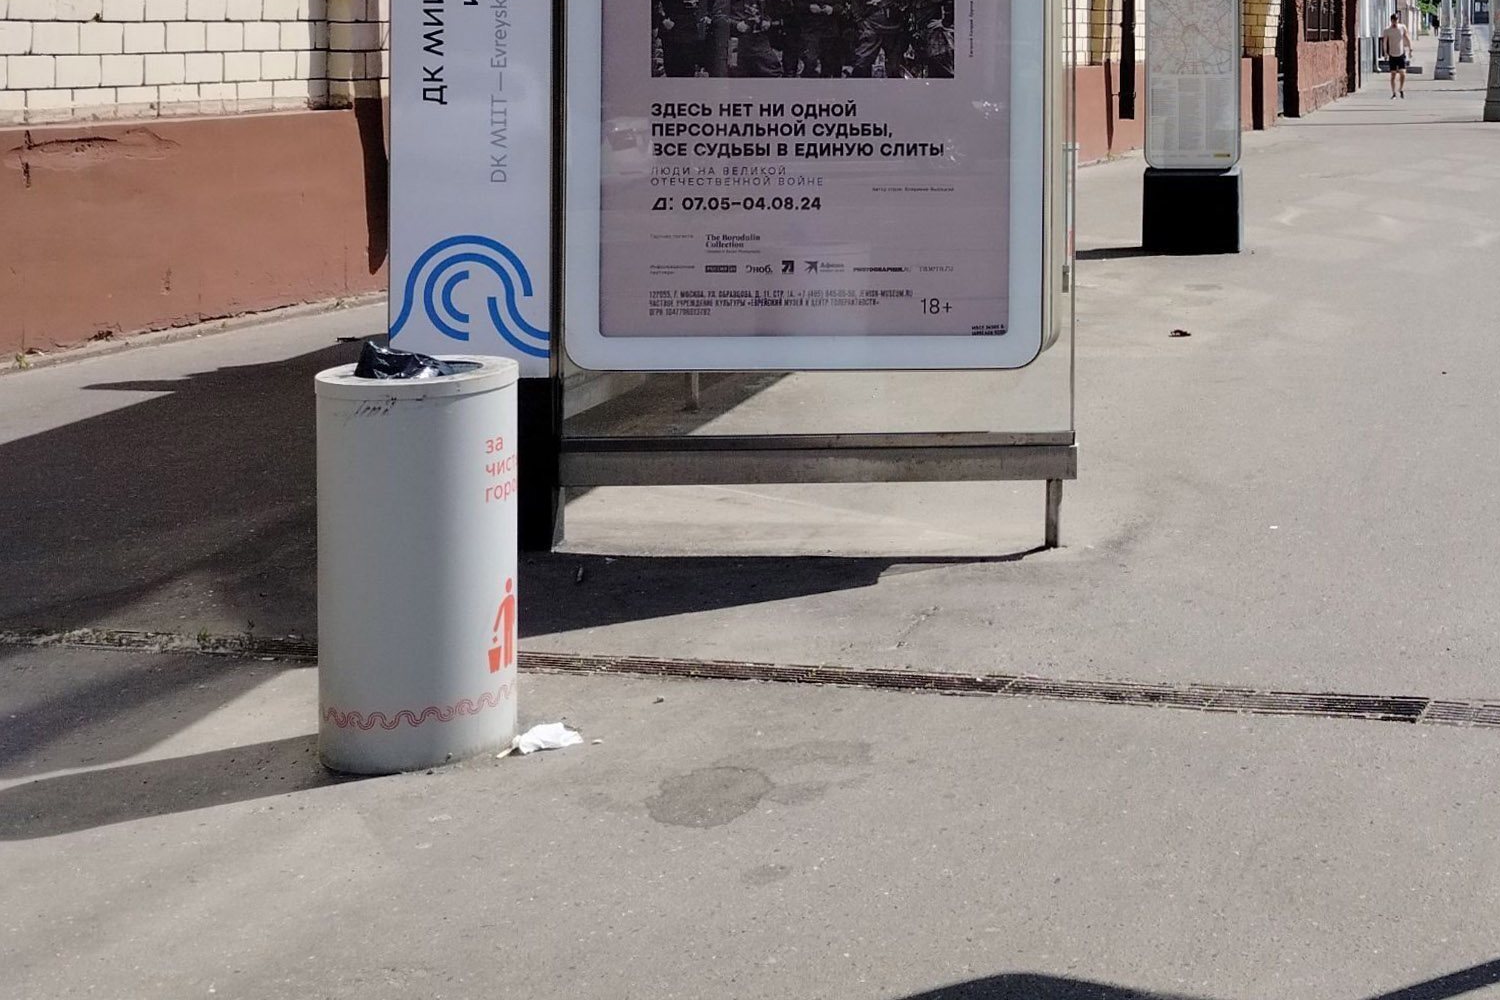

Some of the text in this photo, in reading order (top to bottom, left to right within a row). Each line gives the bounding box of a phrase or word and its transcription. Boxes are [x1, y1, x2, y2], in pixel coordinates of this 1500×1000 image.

[422, 65, 448, 105] ДК
[651, 100, 857, 119] ЗДЕСЬ НЕТ НИ ОДНОЙ
[490, 95, 508, 148] MIIT
[651, 120, 893, 139] ПЕРСОНАЛЬНОЙ СУДЬБЫ,
[652, 142, 945, 159] ВСЕ СУДЬБЫ В ЕДИНУЮ СЛИТЫ
[490, 154, 507, 183] DK
[651, 165, 787, 176] ЛЮДИ НА ВЕЛИКОЙ
[650, 176, 824, 186] ОТЕЧЕСТВЕННОЙ ВОЙНЕ
[705, 240, 744, 248] Collection
[722, 234, 760, 242] Borodulin
[920, 298, 952, 314] 18+
[486, 436, 504, 454] за
